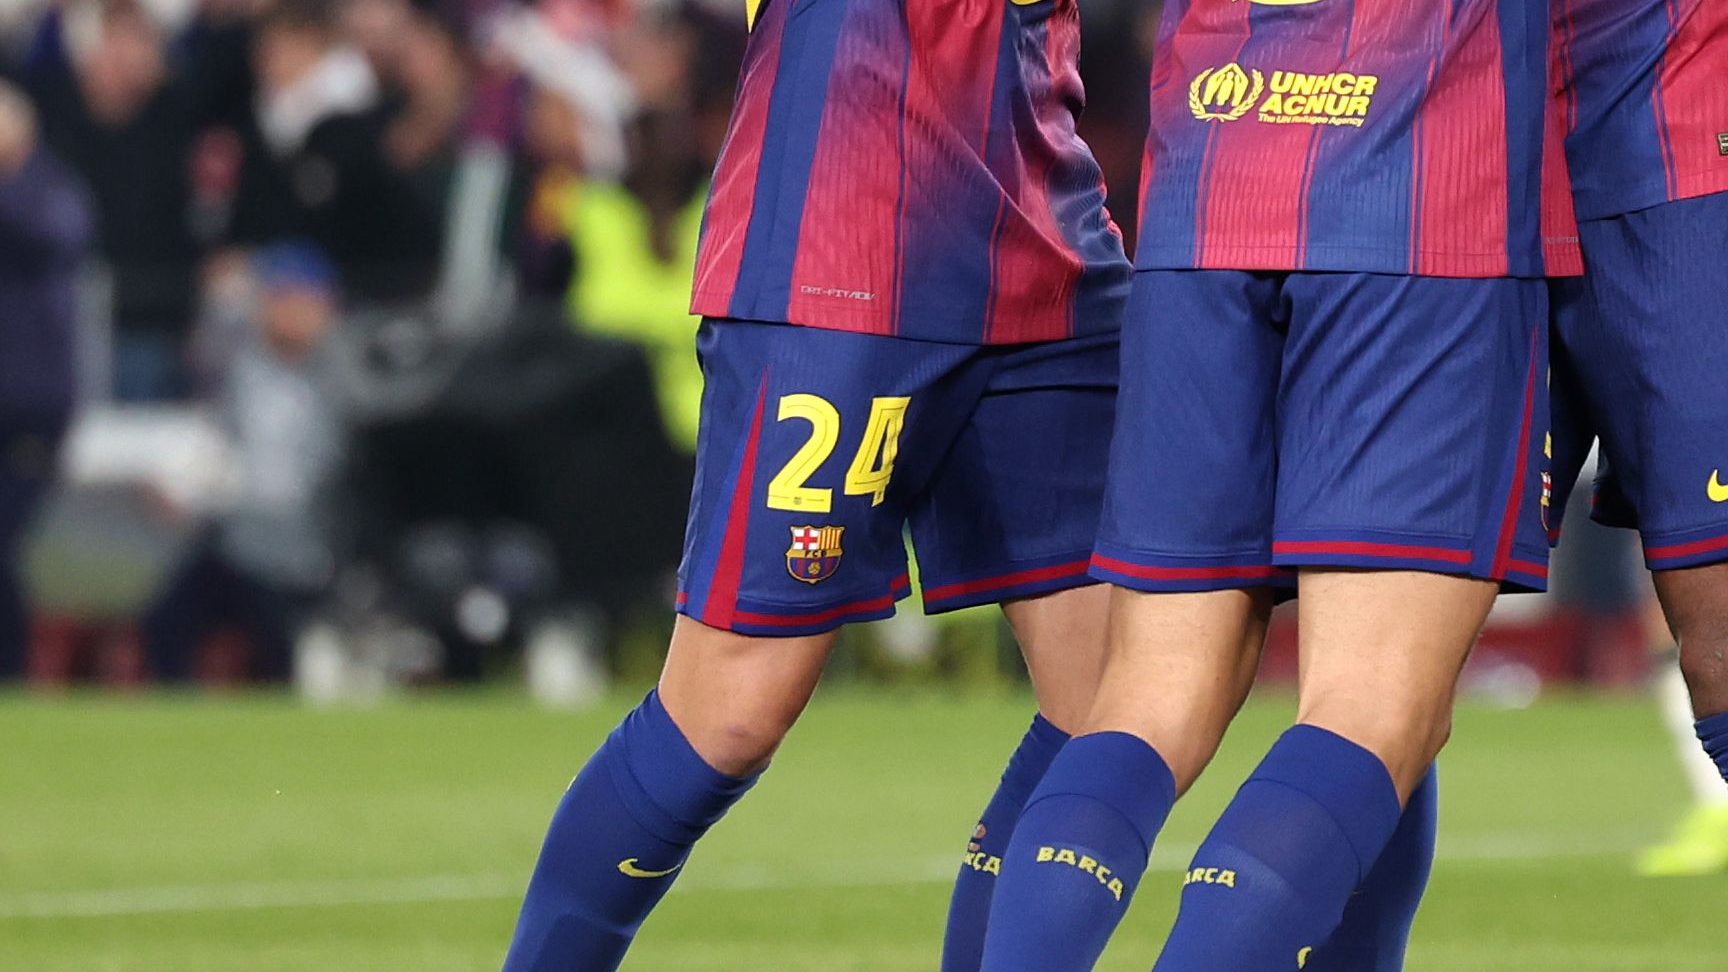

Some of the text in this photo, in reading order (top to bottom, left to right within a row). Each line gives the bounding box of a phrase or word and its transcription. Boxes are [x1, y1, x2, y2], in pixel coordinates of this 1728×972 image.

[1269, 70, 1378, 96] UNHCR
[1258, 93, 1370, 116] ACNUR
[1258, 113, 1276, 123] The
[1328, 116, 1365, 127] Agency
[766, 393, 912, 513] 24
